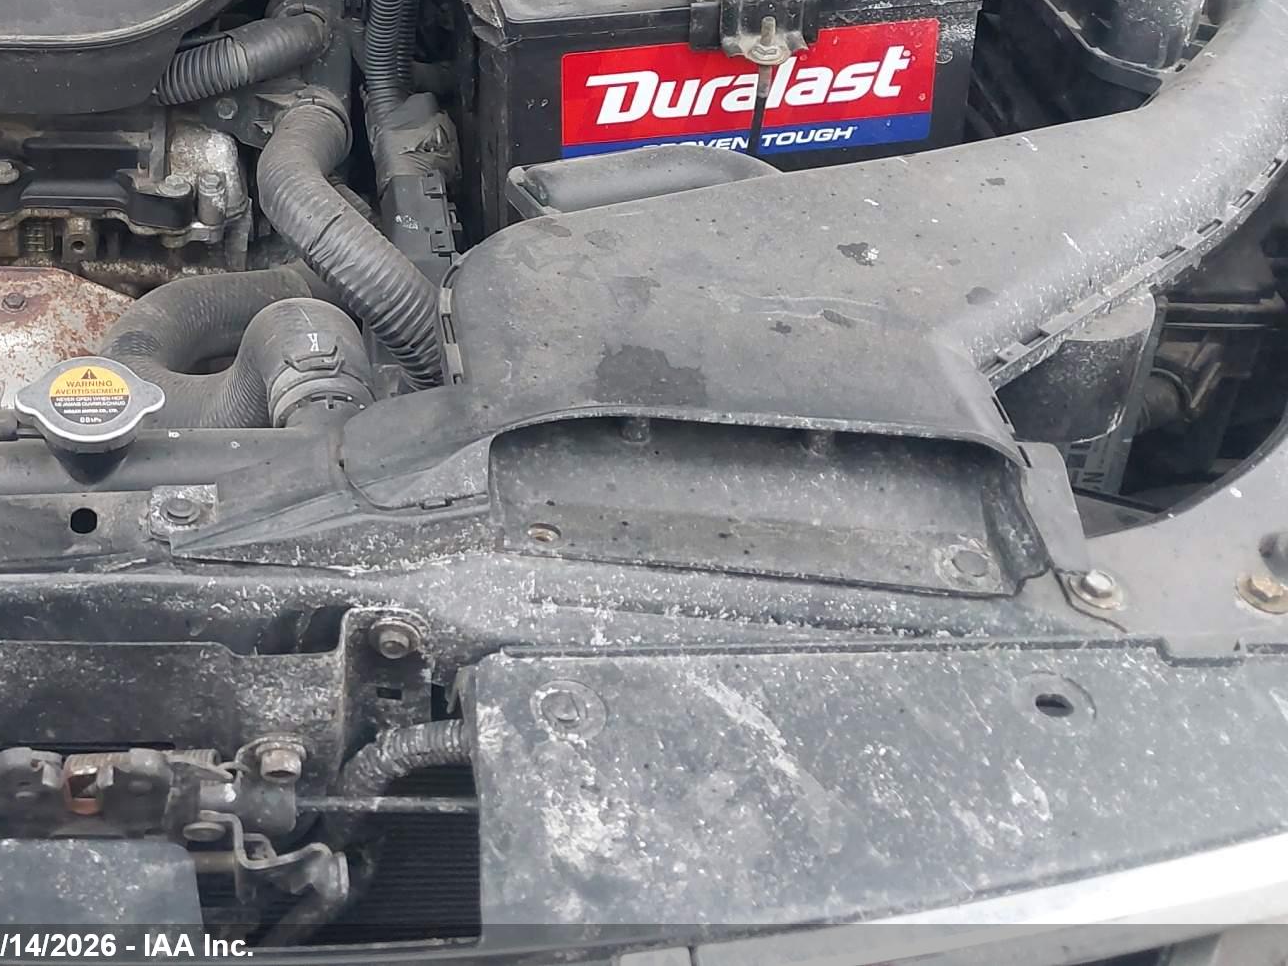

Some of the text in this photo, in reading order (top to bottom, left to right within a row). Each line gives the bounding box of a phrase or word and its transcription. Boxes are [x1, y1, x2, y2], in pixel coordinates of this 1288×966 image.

[585, 45, 911, 125] Duralast
[761, 126, 853, 147] TOUGH
[66, 380, 113, 388] WARNING
